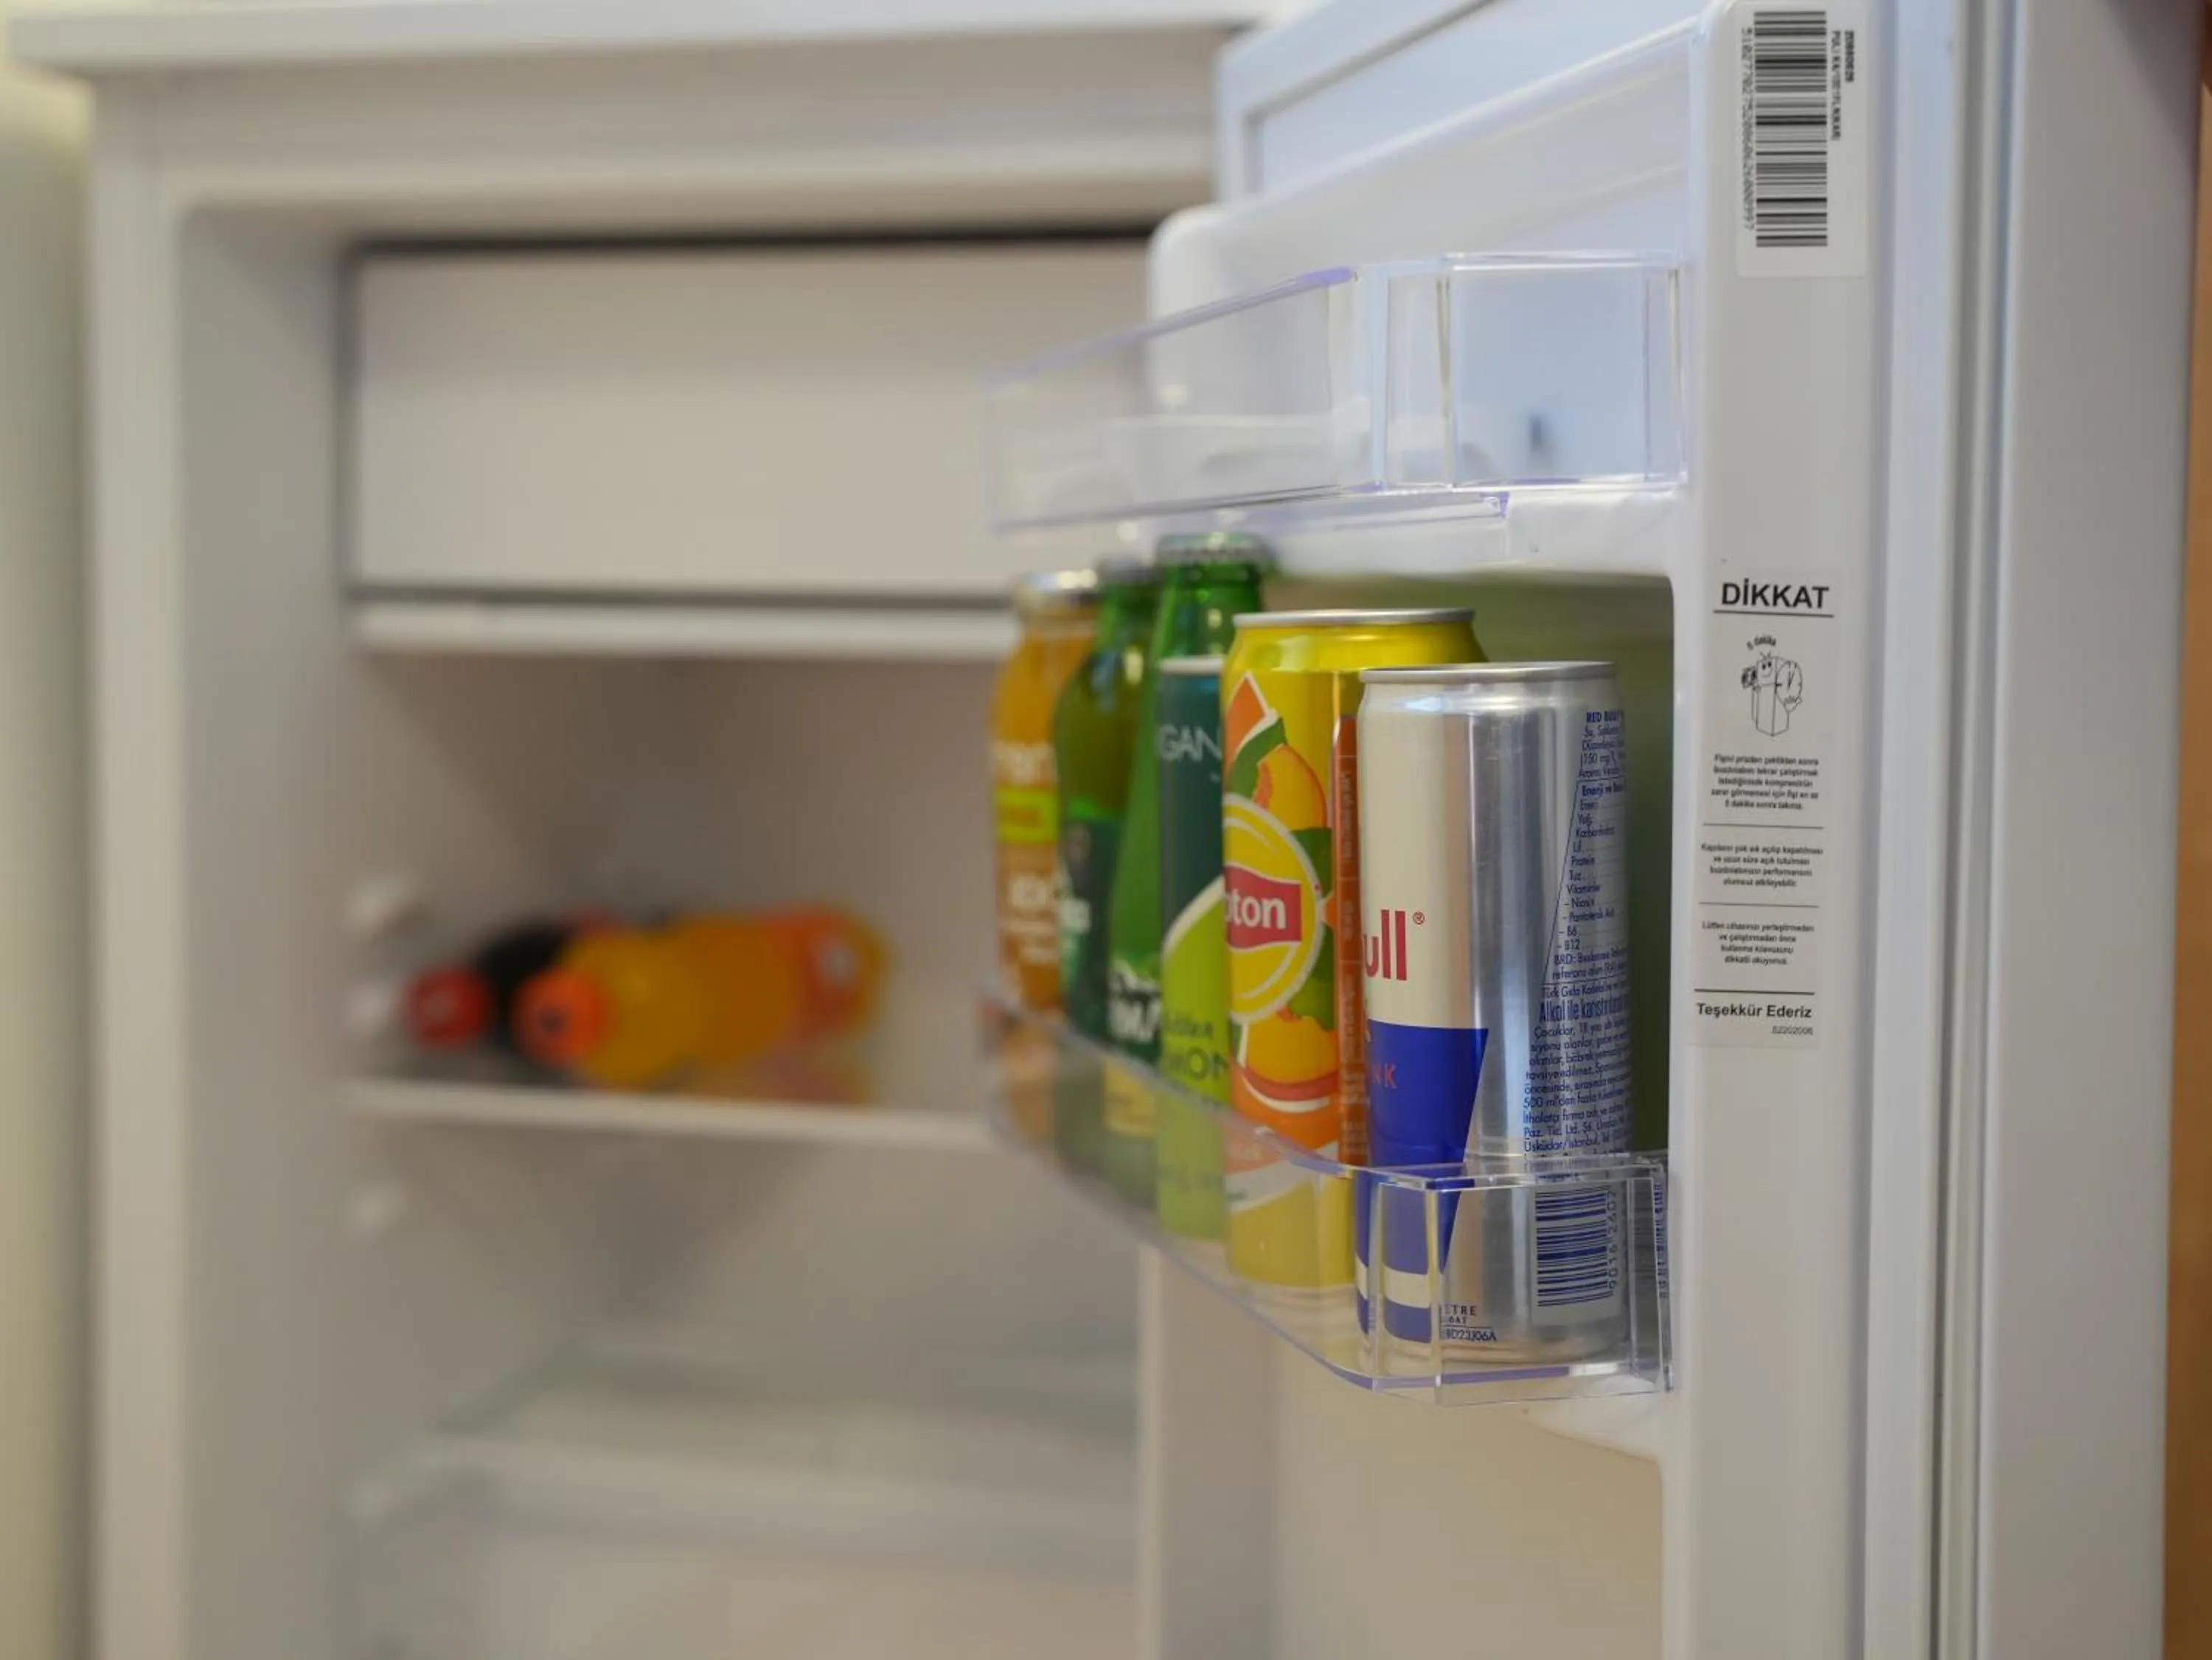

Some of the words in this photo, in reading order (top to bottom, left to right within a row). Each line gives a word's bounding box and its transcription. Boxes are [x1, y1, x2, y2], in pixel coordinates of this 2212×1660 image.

[1722, 578, 1829, 609] DİKKAT
[1564, 938, 1581, 950] B12
[1539, 1000, 1565, 1022] Alkol
[1567, 999, 1579, 1020] ile
[1697, 1002, 1763, 1019] Teşekkür
[1767, 1004, 1812, 1018] Ederiz
